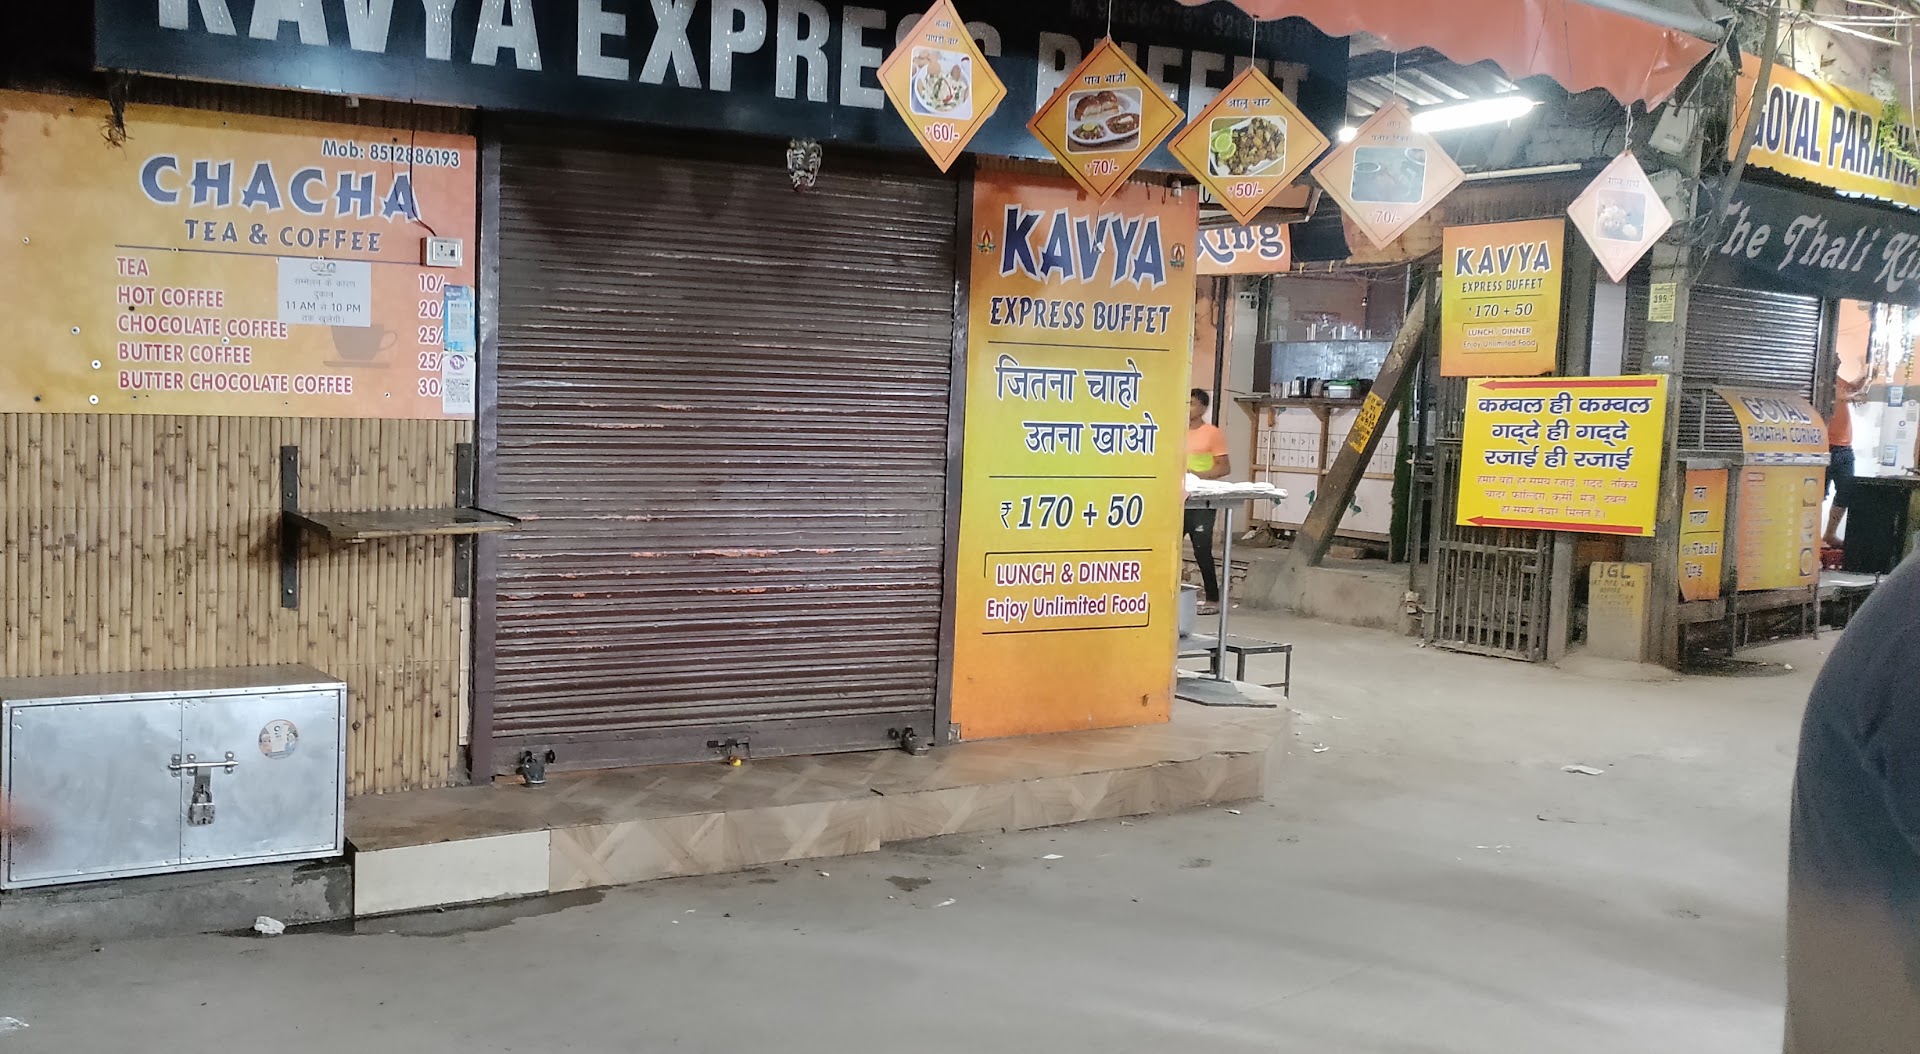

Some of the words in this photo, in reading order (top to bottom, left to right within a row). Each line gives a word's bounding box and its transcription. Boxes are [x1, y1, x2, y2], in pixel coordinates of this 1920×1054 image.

[577, 0, 1001, 112] EXPRE
[1036, 31, 1310, 122] BFFT
[322, 140, 364, 158] Mob:
[370, 144, 459, 167] 8512886193
[140, 154, 420, 222] CHACHA
[185, 219, 238, 243] TEA
[249, 223, 268, 245] &
[280, 226, 381, 252] COFFEE
[1000, 203, 1167, 290] KAVYA
[1778, 214, 1881, 271] Thali
[118, 257, 149, 277] TEA
[1456, 240, 1551, 277] KAVYA
[118, 286, 156, 305] HOT
[161, 288, 224, 307] COFFEE
[1462, 280, 1502, 293] EXPRESS
[1506, 278, 1543, 290] BUFFET
[286, 300, 296, 310] 11
[300, 301, 316, 311] AM
[332, 303, 342, 311] 10
[346, 304, 361, 312] PM
[990, 296, 1085, 329] EXPRESS
[1092, 302, 1172, 334] BUFFET
[1515, 303, 1533, 316] 50
[118, 315, 221, 337] CHOCOLATE
[226, 319, 287, 339] COFFEE
[1468, 328, 1494, 336] LUNCH
[1502, 327, 1531, 335] DINNER
[118, 343, 184, 363] BUTTER
[189, 345, 251, 364] COFFEE
[119, 371, 184, 391] BUTTER
[189, 372, 289, 393] CHOCOLATE
[293, 374, 353, 394] COFFEE
[994, 353, 1078, 402] जितना
[1083, 358, 1143, 409] चाहो
[1478, 397, 1545, 413] कम्बल
[1549, 391, 1573, 414] ही
[1579, 397, 1652, 414] कम्बल
[1022, 420, 1085, 454] उतना
[1090, 412, 1159, 455] खाओ
[1546, 418, 1570, 441] ही
[1484, 445, 1540, 468] रजाई
[1544, 445, 1568, 468] ही
[1574, 447, 1634, 471] रजाई
[1082, 502, 1098, 527] +
[1107, 494, 1144, 527] 50
[996, 563, 1055, 586] LUNCH
[1060, 562, 1074, 583] &
[1079, 560, 1141, 583] DINNER
[986, 597, 1028, 623] Enjoy
[1033, 594, 1106, 617] Unlimited
[1111, 592, 1148, 615] Food
